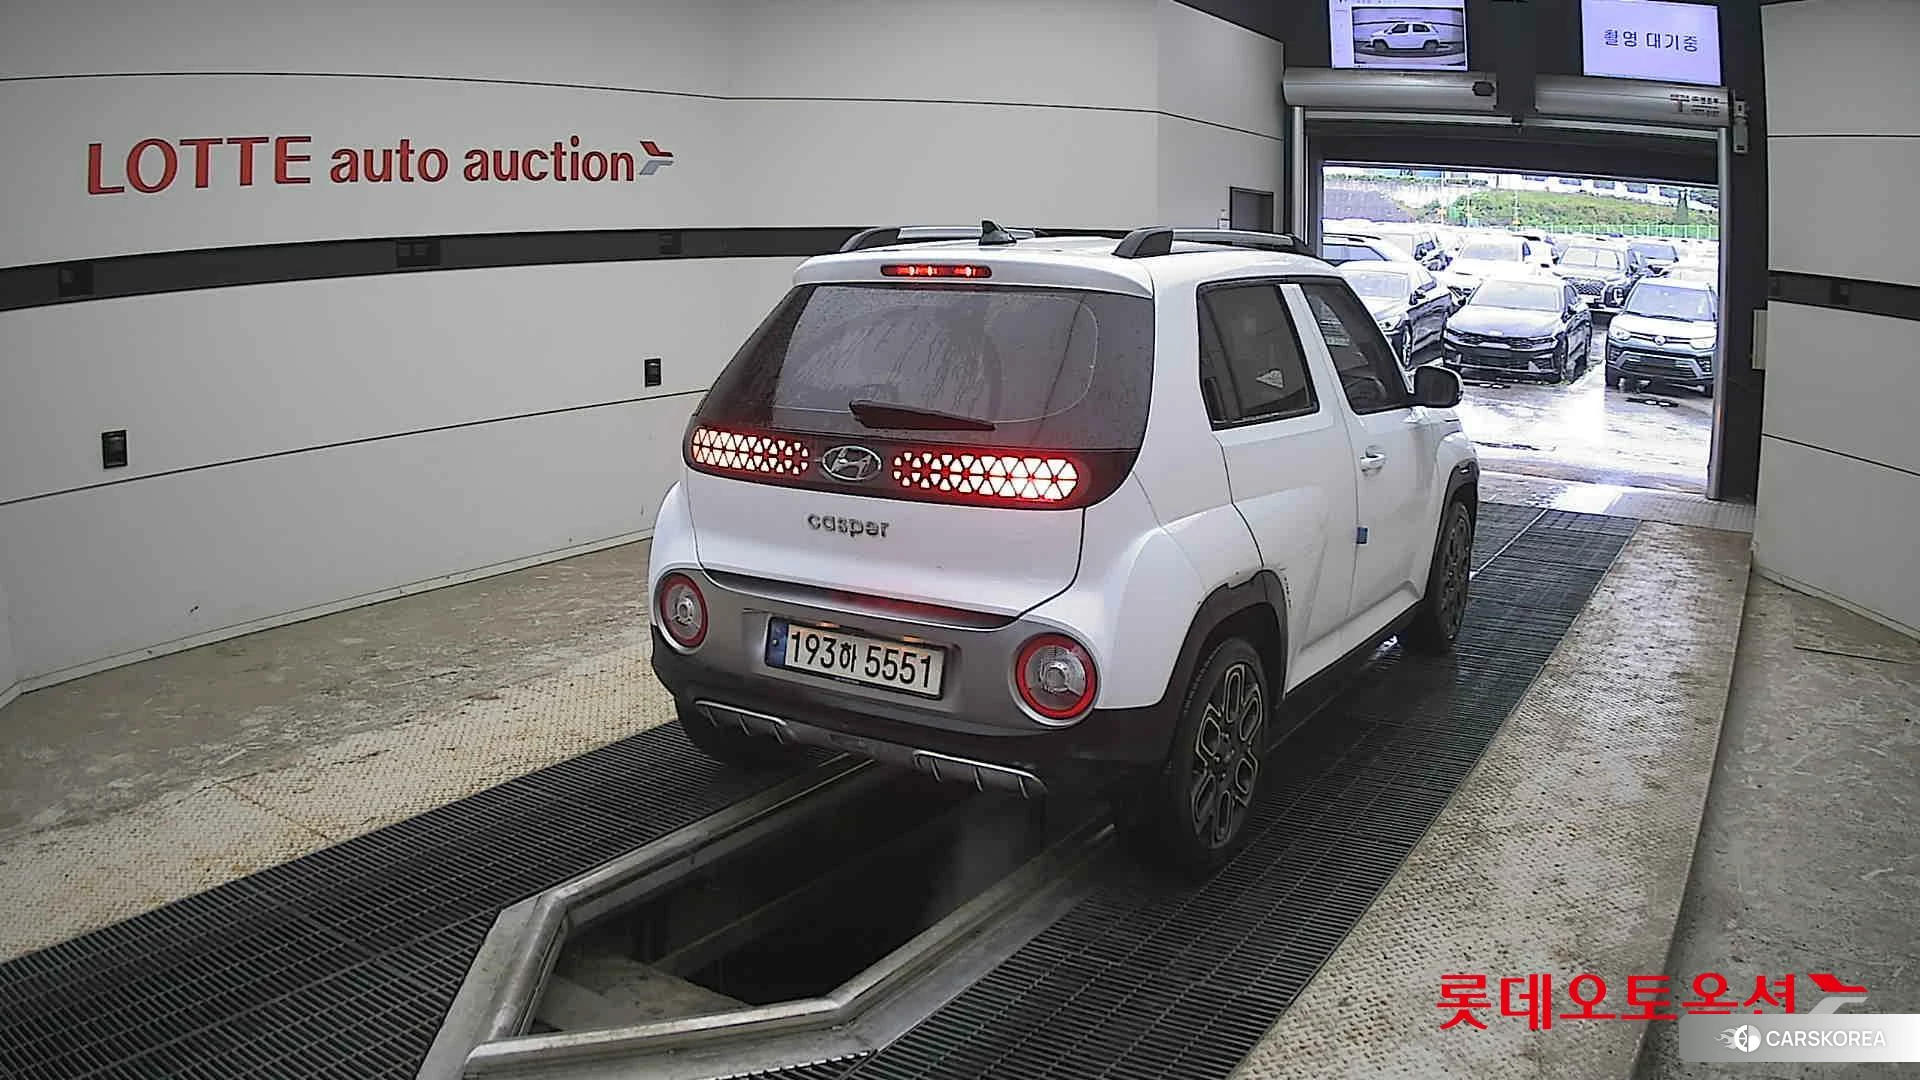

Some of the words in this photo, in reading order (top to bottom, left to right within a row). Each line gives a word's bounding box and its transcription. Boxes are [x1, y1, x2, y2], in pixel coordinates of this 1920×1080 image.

[1646, 32, 1698, 52] 대기중
[88, 136, 311, 195] LOTTE
[329, 139, 449, 184] auto
[463, 135, 635, 183] auction
[807, 513, 889, 538] casper
[791, 631, 857, 673] 193하
[865, 645, 931, 688] 5551
